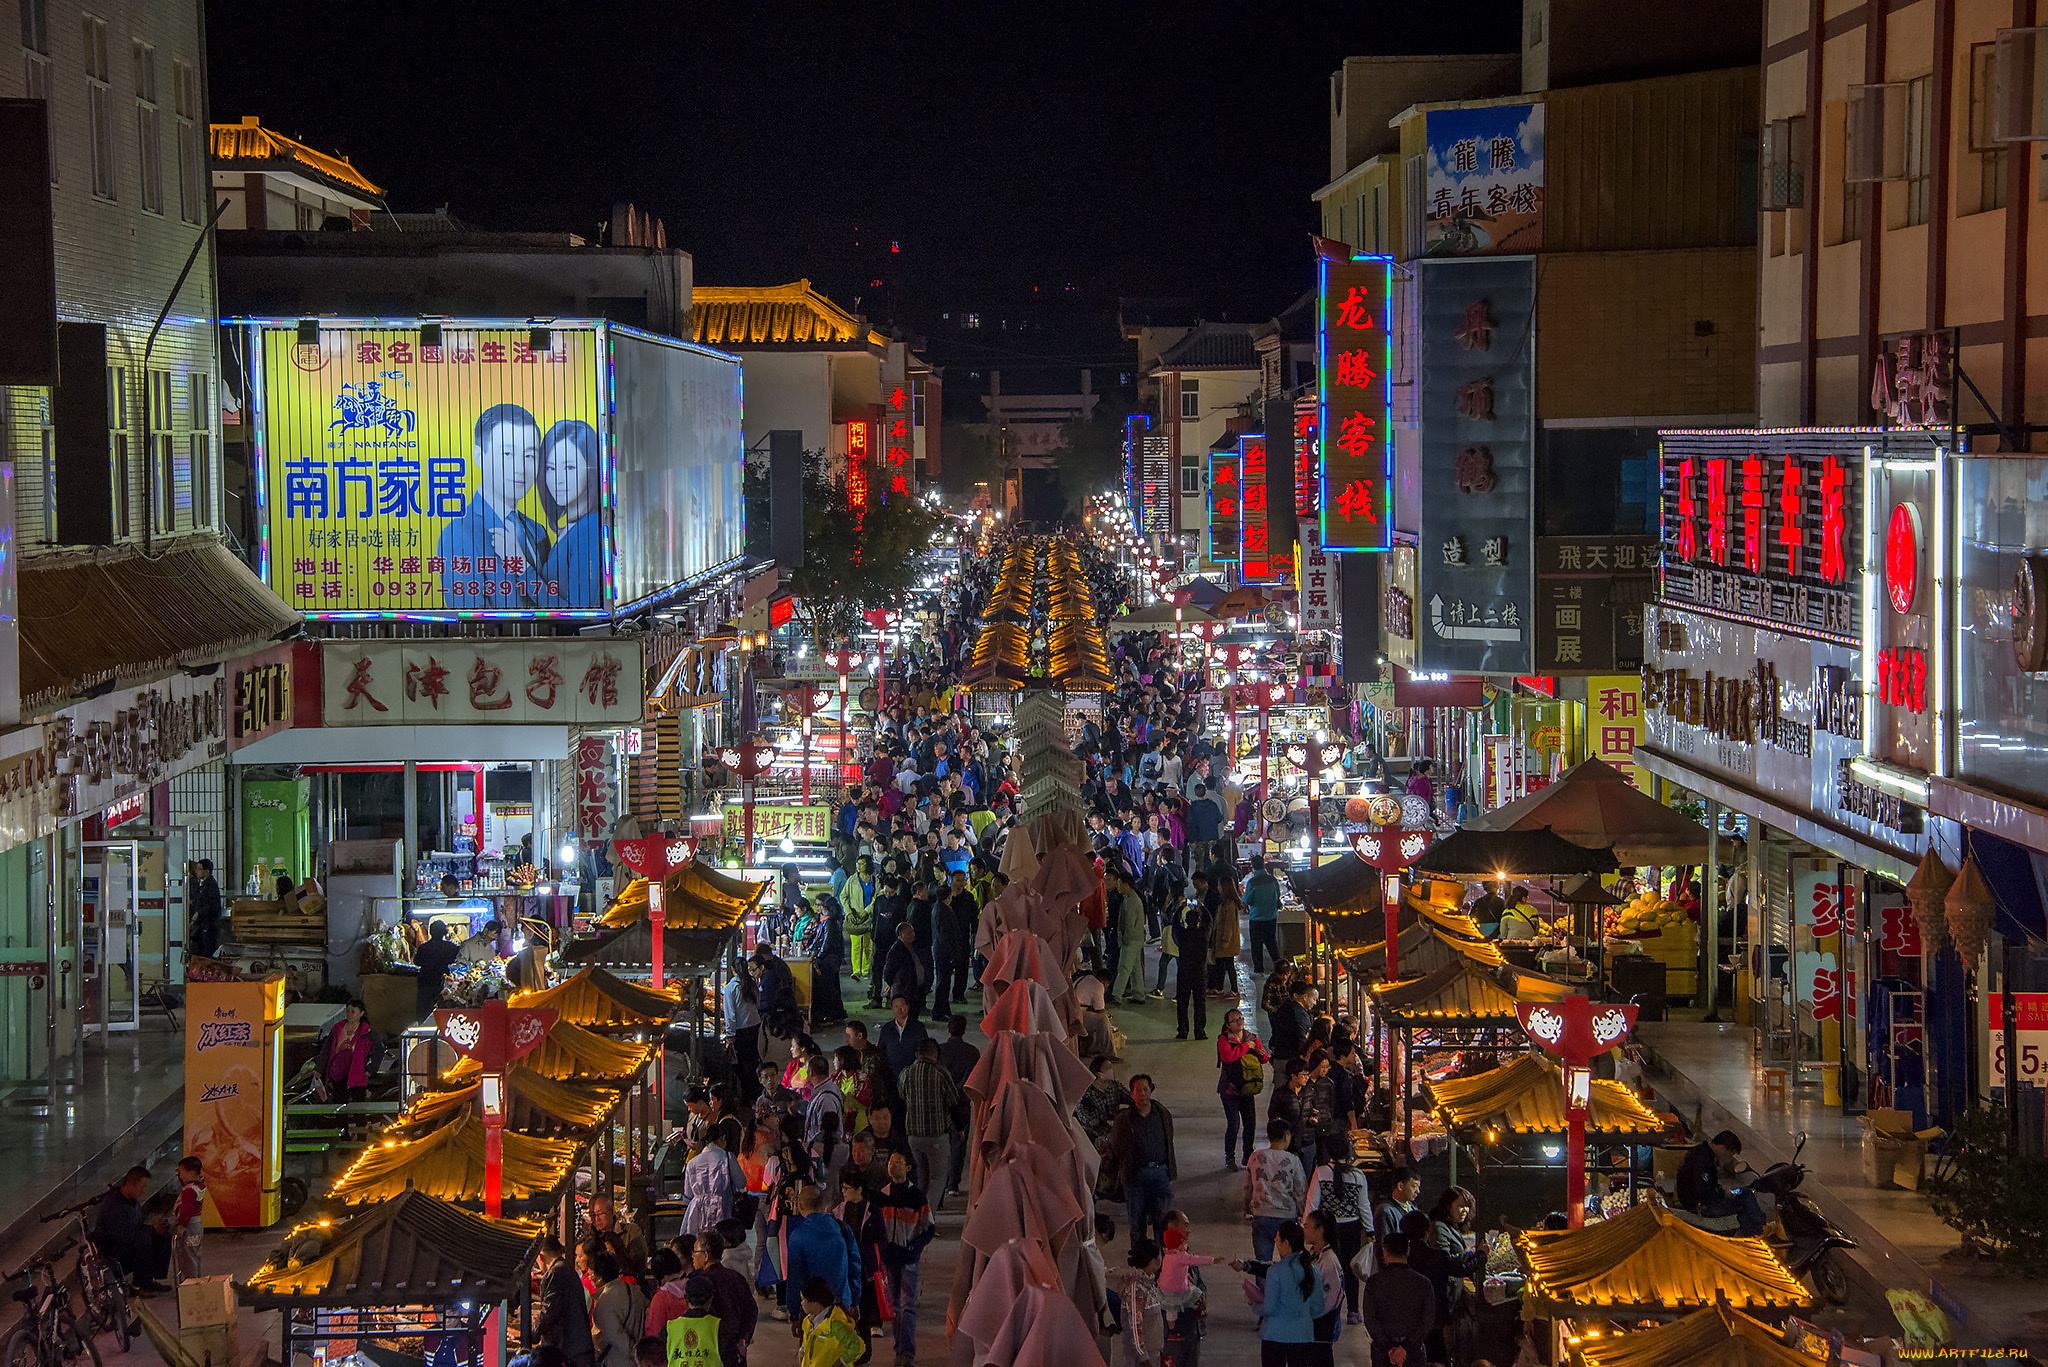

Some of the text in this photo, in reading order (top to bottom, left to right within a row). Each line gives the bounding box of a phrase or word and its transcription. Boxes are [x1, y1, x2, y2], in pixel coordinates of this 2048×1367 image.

[1454, 137, 1516, 172] 龍騰
[1432, 181, 1538, 219] 青年客棧
[1335, 285, 1377, 525] 龙腾客栈
[354, 440, 417, 449] NANFANG
[888, 386, 912, 498] 奇石珍藏
[284, 456, 467, 520] 南方家居
[372, 555, 526, 576] 华盛商场四楼
[1442, 536, 1505, 568] 造型
[372, 580, 561, 597] 0937-8839176
[1553, 585, 1583, 600] 二楼
[1450, 599, 1521, 627] 请上二楼
[1554, 604, 1583, 664] 画展
[1618, 659, 1637, 669] DUN
[343, 653, 624, 712] 天津包子馆
[198, 1022, 251, 1051] 冰红茶
